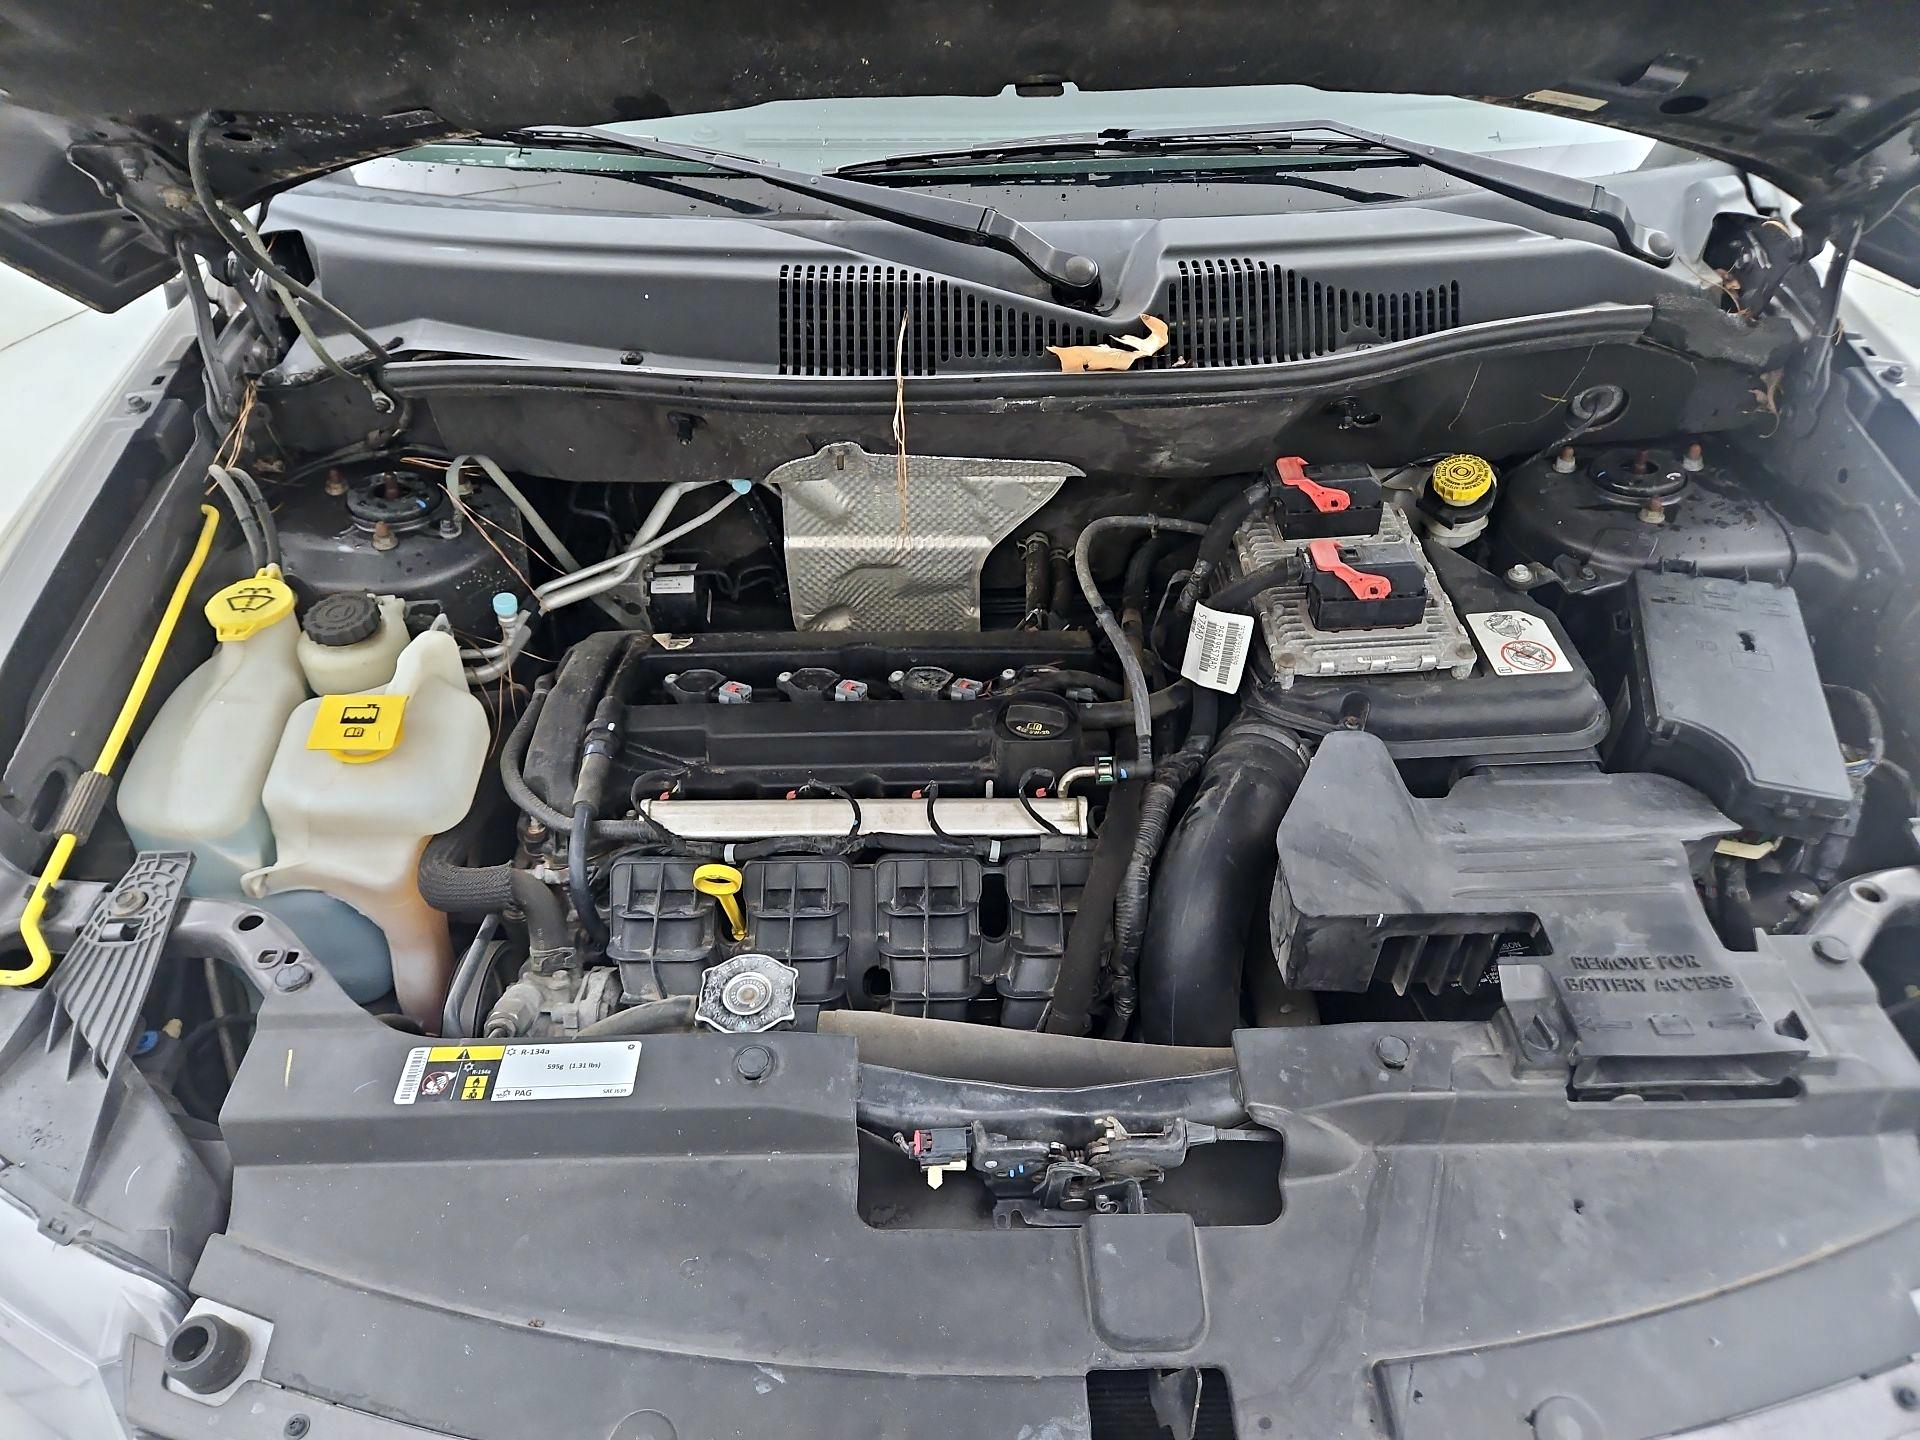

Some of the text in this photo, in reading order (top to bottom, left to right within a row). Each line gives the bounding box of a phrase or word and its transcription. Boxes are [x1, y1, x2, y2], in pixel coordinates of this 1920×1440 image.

[1570, 954, 1702, 970] REMOVE FOR
[1563, 975, 1735, 993] BATTERY ACCESS
[520, 1048, 550, 1056] R-134a
[546, 1061, 601, 1071] 595g (1.31 lbs)
[514, 1089, 533, 1097] PAG
